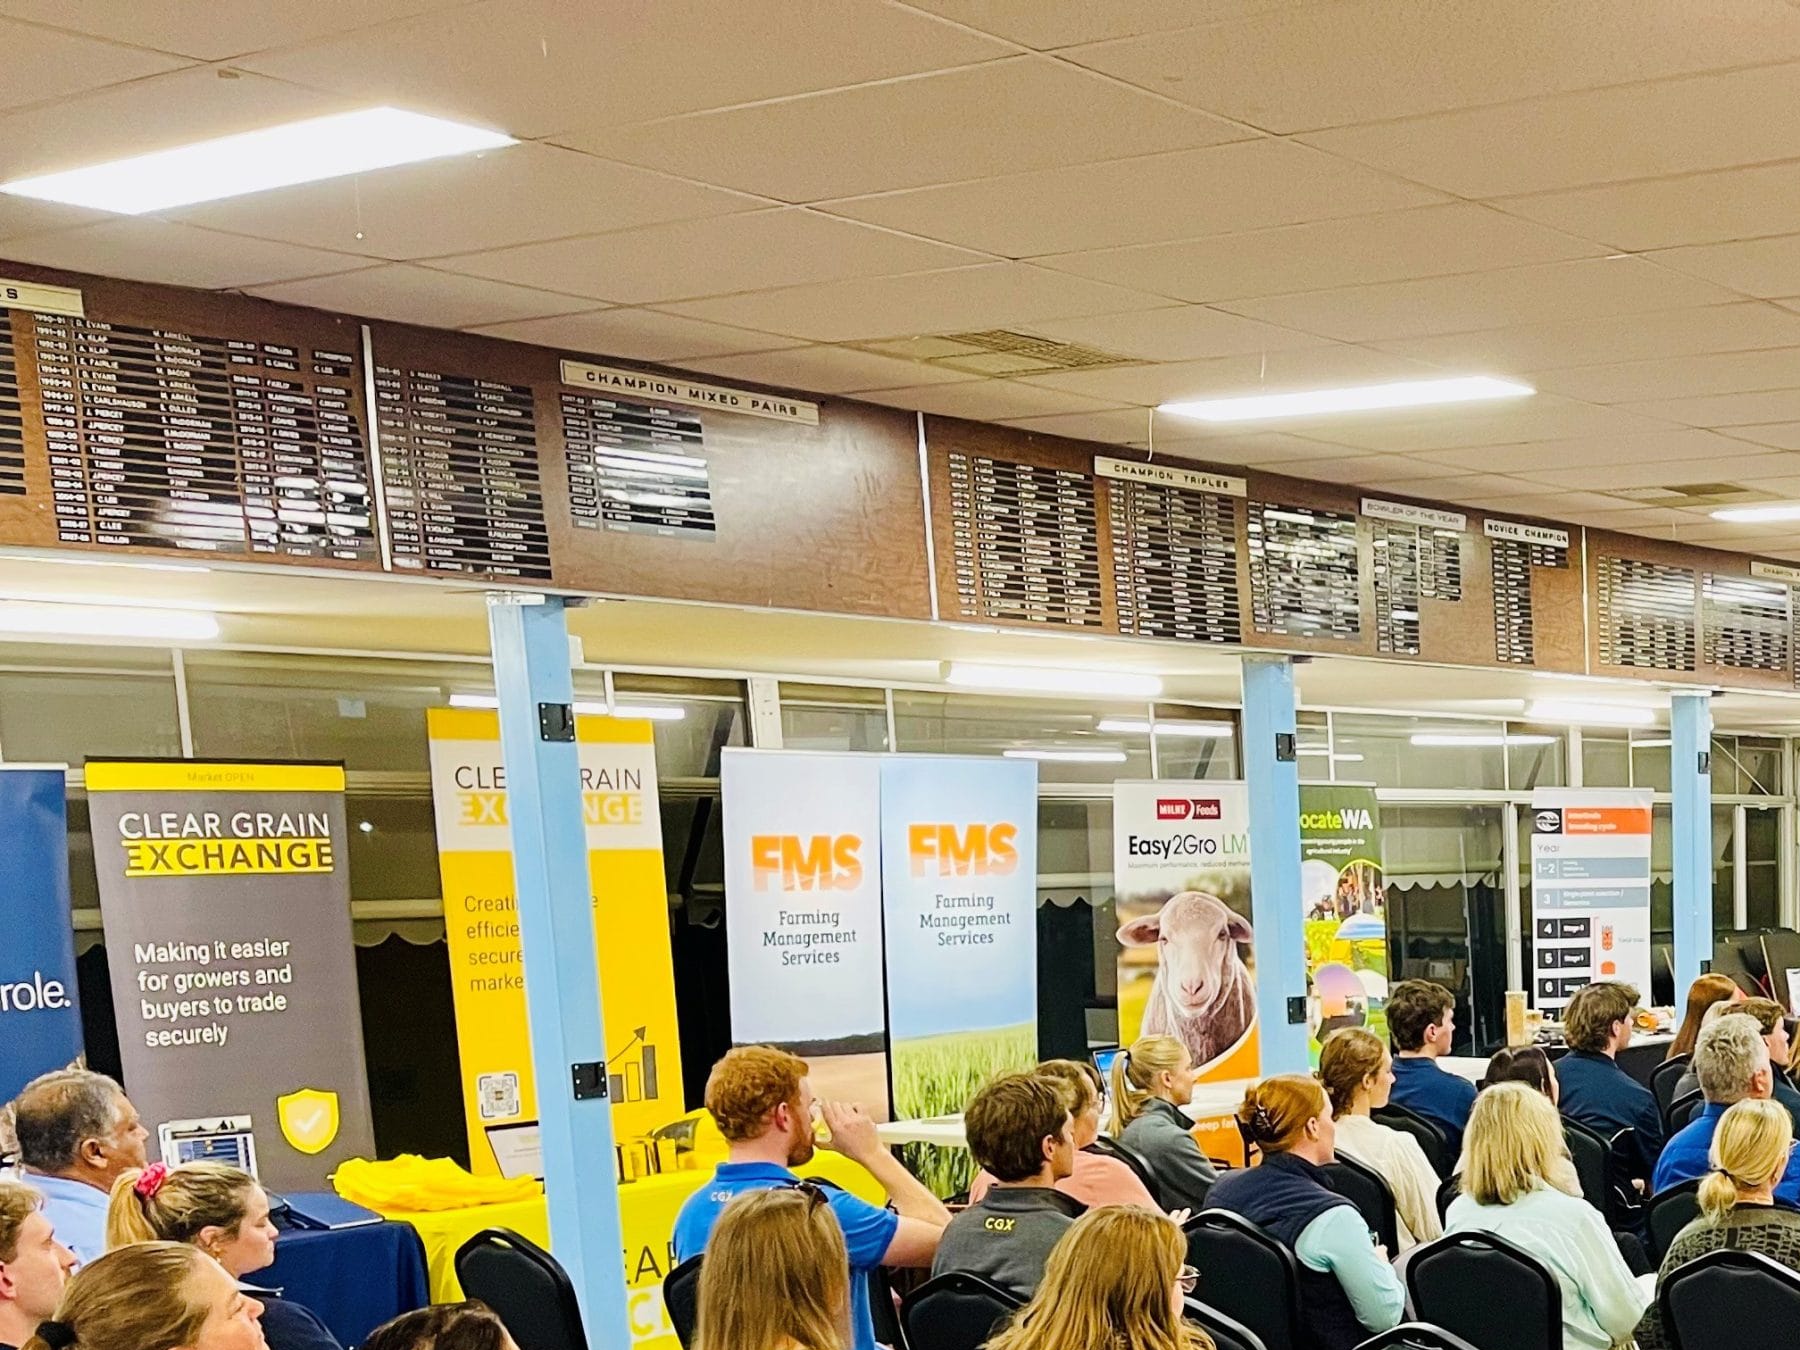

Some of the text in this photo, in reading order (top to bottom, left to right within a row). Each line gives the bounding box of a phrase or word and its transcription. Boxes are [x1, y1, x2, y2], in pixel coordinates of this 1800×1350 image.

[586, 372, 797, 416] CHAMPION MIXED PAIRS
[1114, 464, 1229, 489] CHAMPION TRIPLES
[1367, 503, 1460, 525] BOWLER OF THE YEAR
[1487, 523, 1568, 543] NOVICE CHAMPION
[187, 771, 255, 782] Market OPEN
[454, 766, 642, 791] CLE RAIN
[1159, 804, 1219, 816] MILNE Feeds
[1300, 808, 1374, 830] ocateWA
[119, 812, 330, 839] CLEAR GRAIN
[908, 822, 1018, 878] FMS
[1128, 833, 1247, 860] Easy2Gro LM
[1537, 844, 1560, 853] Year
[128, 842, 334, 871] EXCHANGE
[751, 834, 863, 892] FMS
[464, 895, 518, 913] Creati
[935, 892, 995, 911] Farming
[1543, 894, 1551, 905] 3
[779, 909, 840, 928] Farming
[919, 912, 1011, 930] Management
[1543, 922, 1553, 934] 4
[466, 921, 520, 940] efficie
[763, 929, 857, 948] Management
[938, 930, 994, 946] Services
[134, 938, 290, 965] Making it easier
[782, 949, 840, 966] Services
[1544, 952, 1553, 964] 5
[137, 963, 293, 994] for growers and
[470, 973, 524, 992] marke
[1544, 980, 1553, 993] 6
[0, 970, 72, 1011] role.
[140, 990, 287, 1023] buyers to trade
[145, 1022, 228, 1047] securely
[985, 1217, 1016, 1231] CGX
